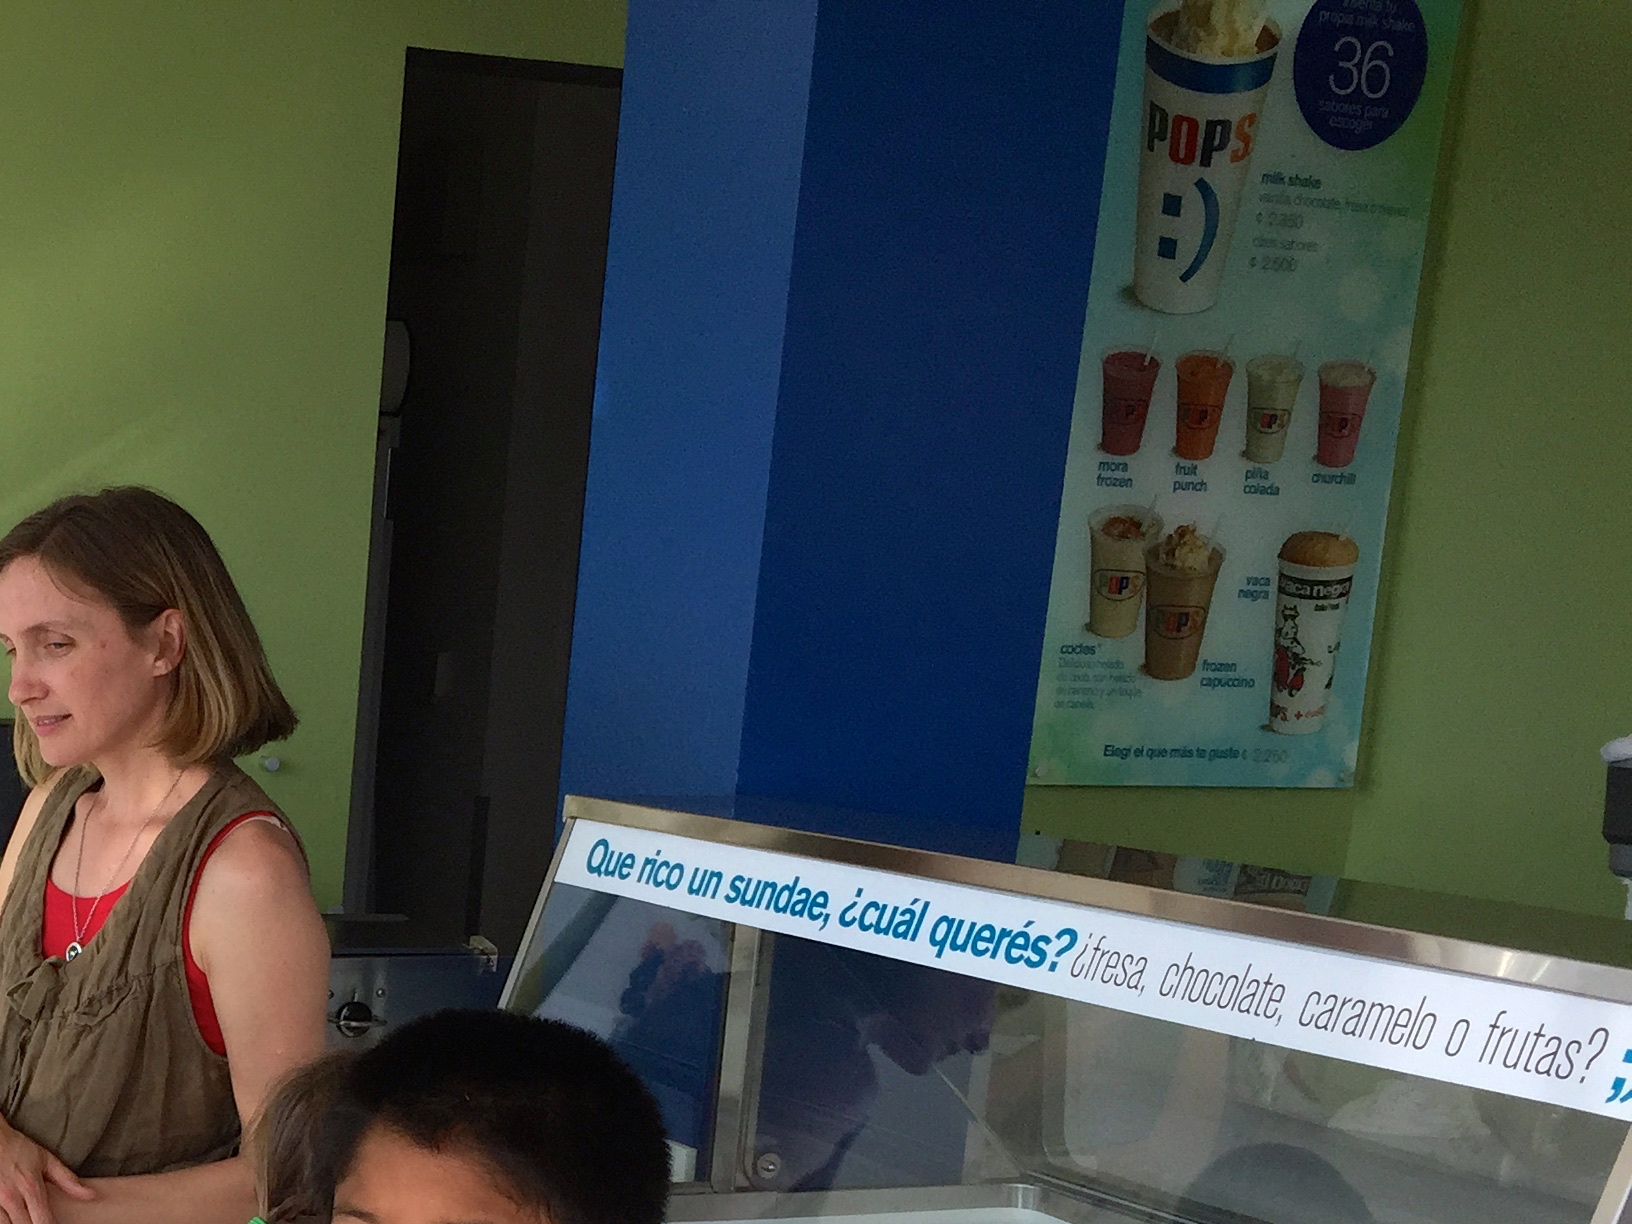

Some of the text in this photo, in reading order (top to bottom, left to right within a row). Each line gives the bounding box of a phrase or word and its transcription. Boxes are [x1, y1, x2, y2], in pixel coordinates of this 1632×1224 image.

[1328, 36, 1394, 99] 36
[1147, 99, 1257, 168] POPS
[1260, 172, 1322, 189] milk shake
[1098, 461, 1128, 473] mora
[1175, 462, 1197, 477] fruit
[1096, 473, 1133, 488] frozen
[1172, 478, 1208, 493] punch
[1243, 482, 1280, 496] colada
[1246, 575, 1271, 587] vaca
[1237, 588, 1270, 602] negra
[1202, 659, 1237, 673] frozen
[1146, 747, 1168, 761] que
[586, 838, 1610, 1084] Que rico un sundae, ¿cuál querés? ¿fresa, chocolate, caramelo o frutas?
